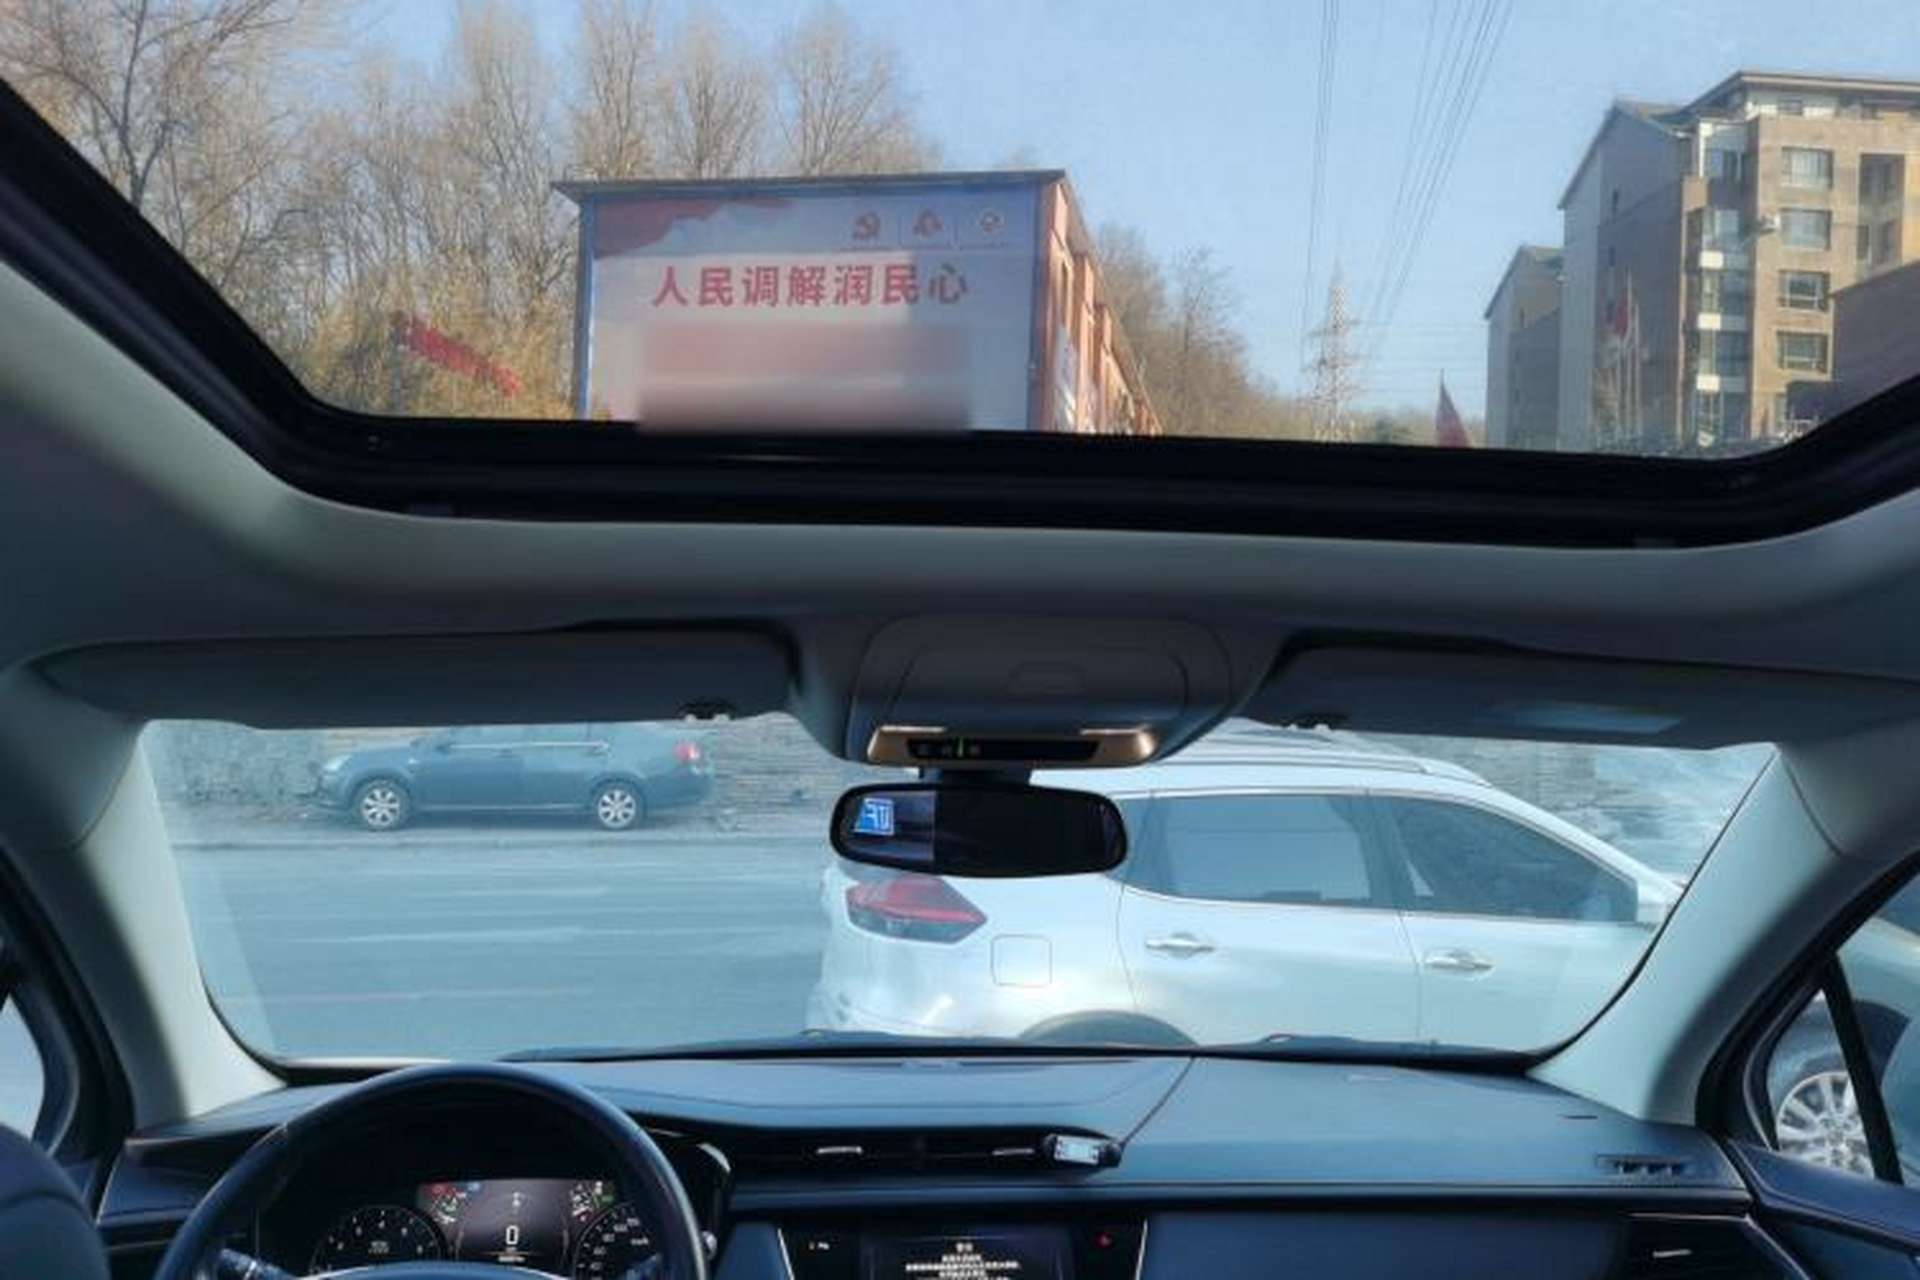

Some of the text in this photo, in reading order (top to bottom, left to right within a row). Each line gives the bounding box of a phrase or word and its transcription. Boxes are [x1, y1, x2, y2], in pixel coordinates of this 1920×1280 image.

[653, 264, 968, 307] 人民调解润民心
[505, 1225, 520, 1246] 0
